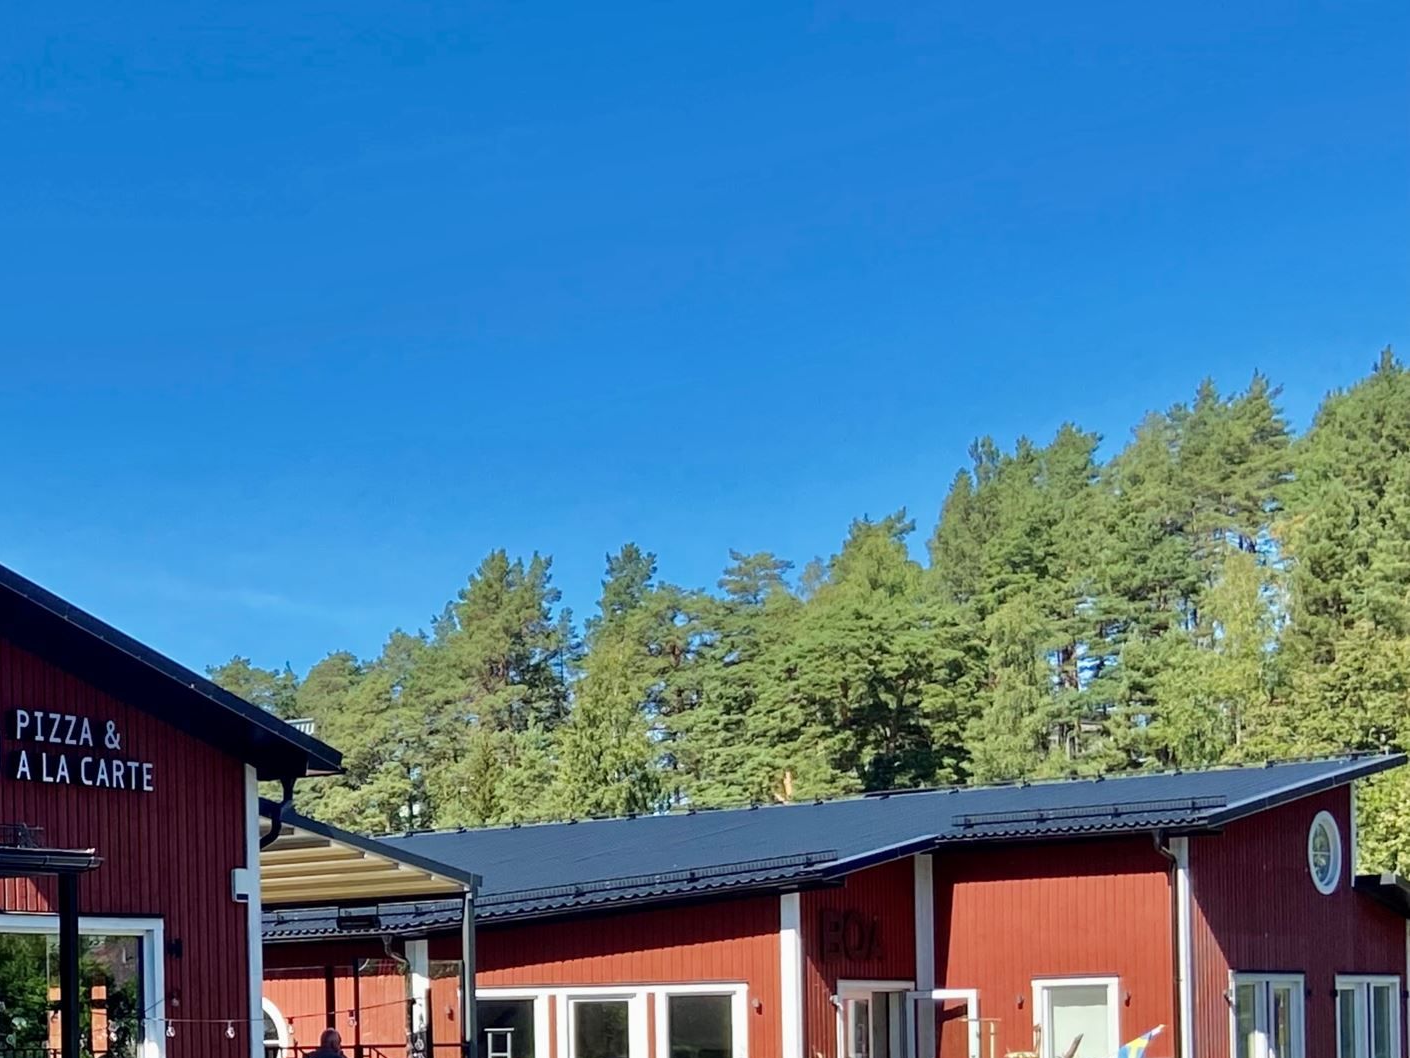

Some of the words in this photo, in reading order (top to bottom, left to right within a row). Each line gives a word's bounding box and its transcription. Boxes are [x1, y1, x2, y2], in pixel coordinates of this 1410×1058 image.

[16, 709, 93, 747] PIZZA
[104, 720, 121, 750] &
[16, 750, 31, 780] A
[42, 752, 70, 784] LA
[80, 757, 154, 791] CARTE
